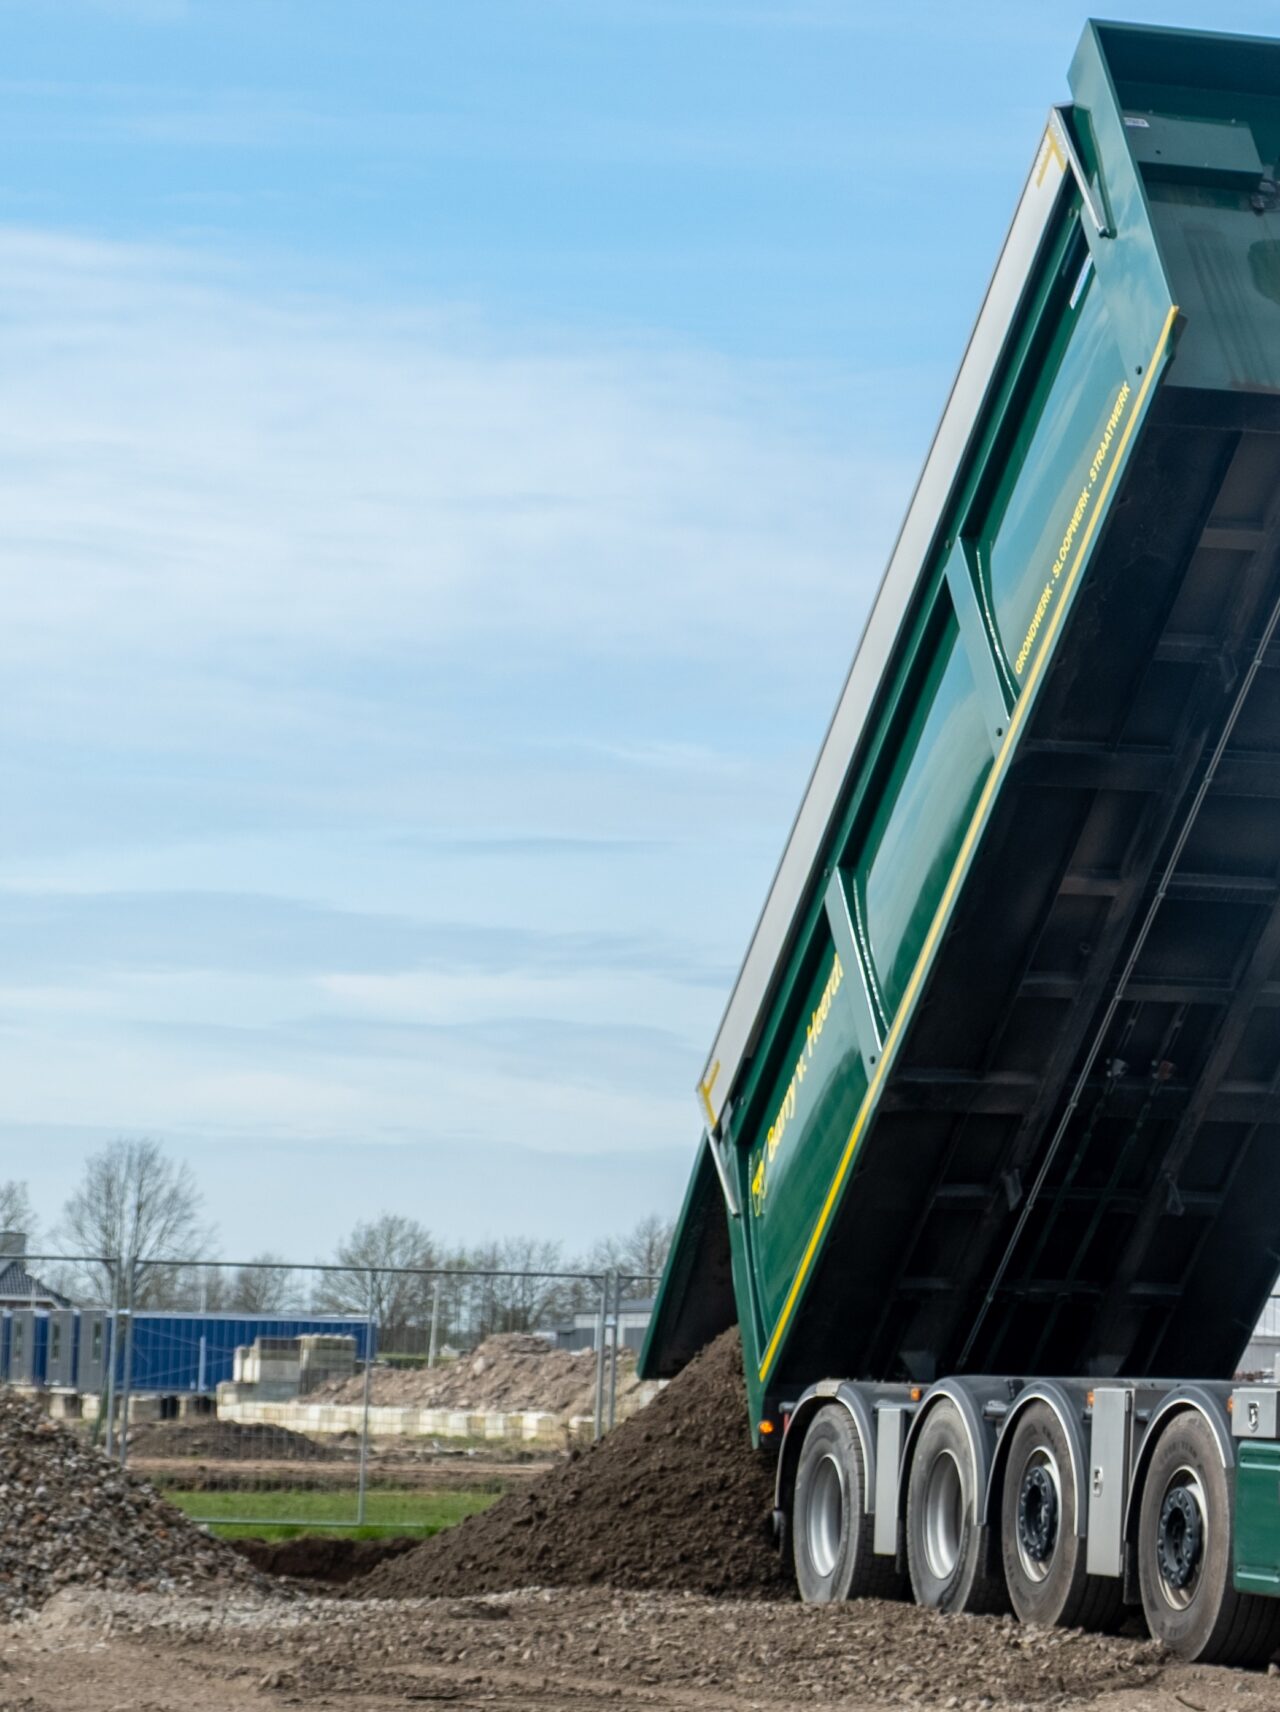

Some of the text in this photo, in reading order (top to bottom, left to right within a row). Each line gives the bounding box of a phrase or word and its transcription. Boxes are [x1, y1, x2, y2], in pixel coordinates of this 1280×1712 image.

[1014, 586, 1054, 675] GRONDWERK
[1051, 486, 1091, 579] SLOOPWERK
[1088, 380, 1132, 484] STRAATWERK
